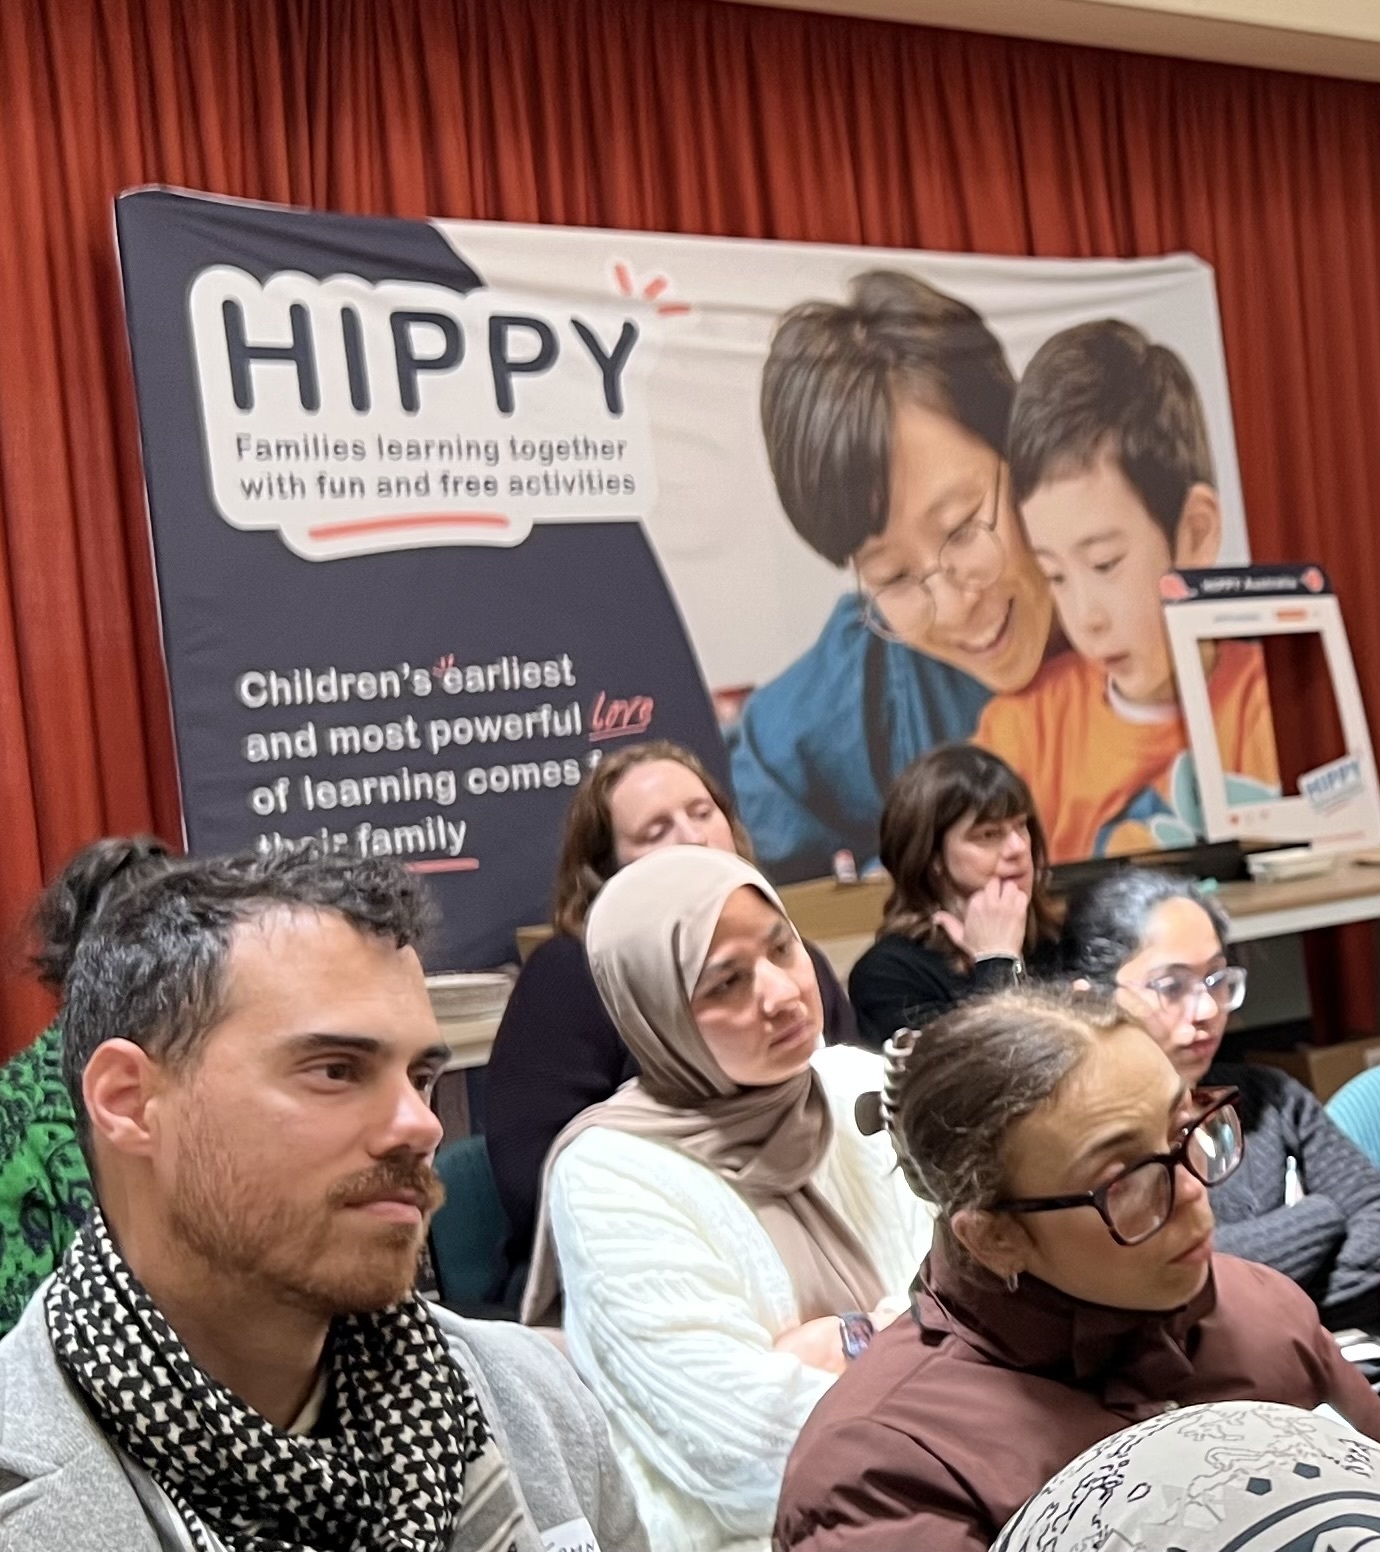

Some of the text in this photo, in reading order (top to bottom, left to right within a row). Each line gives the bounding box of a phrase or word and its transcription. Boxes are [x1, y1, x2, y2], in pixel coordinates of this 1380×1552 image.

[222, 298, 640, 418] HIPPY
[235, 433, 628, 466] Families learning together
[240, 469, 637, 500] with fun and free activities
[239, 653, 576, 709] Children's earliest
[245, 721, 318, 762] and
[329, 714, 421, 756] most
[430, 701, 582, 755] powerful
[252, 777, 289, 816] of
[304, 766, 457, 811] learning
[467, 757, 581, 795] comes
[358, 814, 467, 858] family
